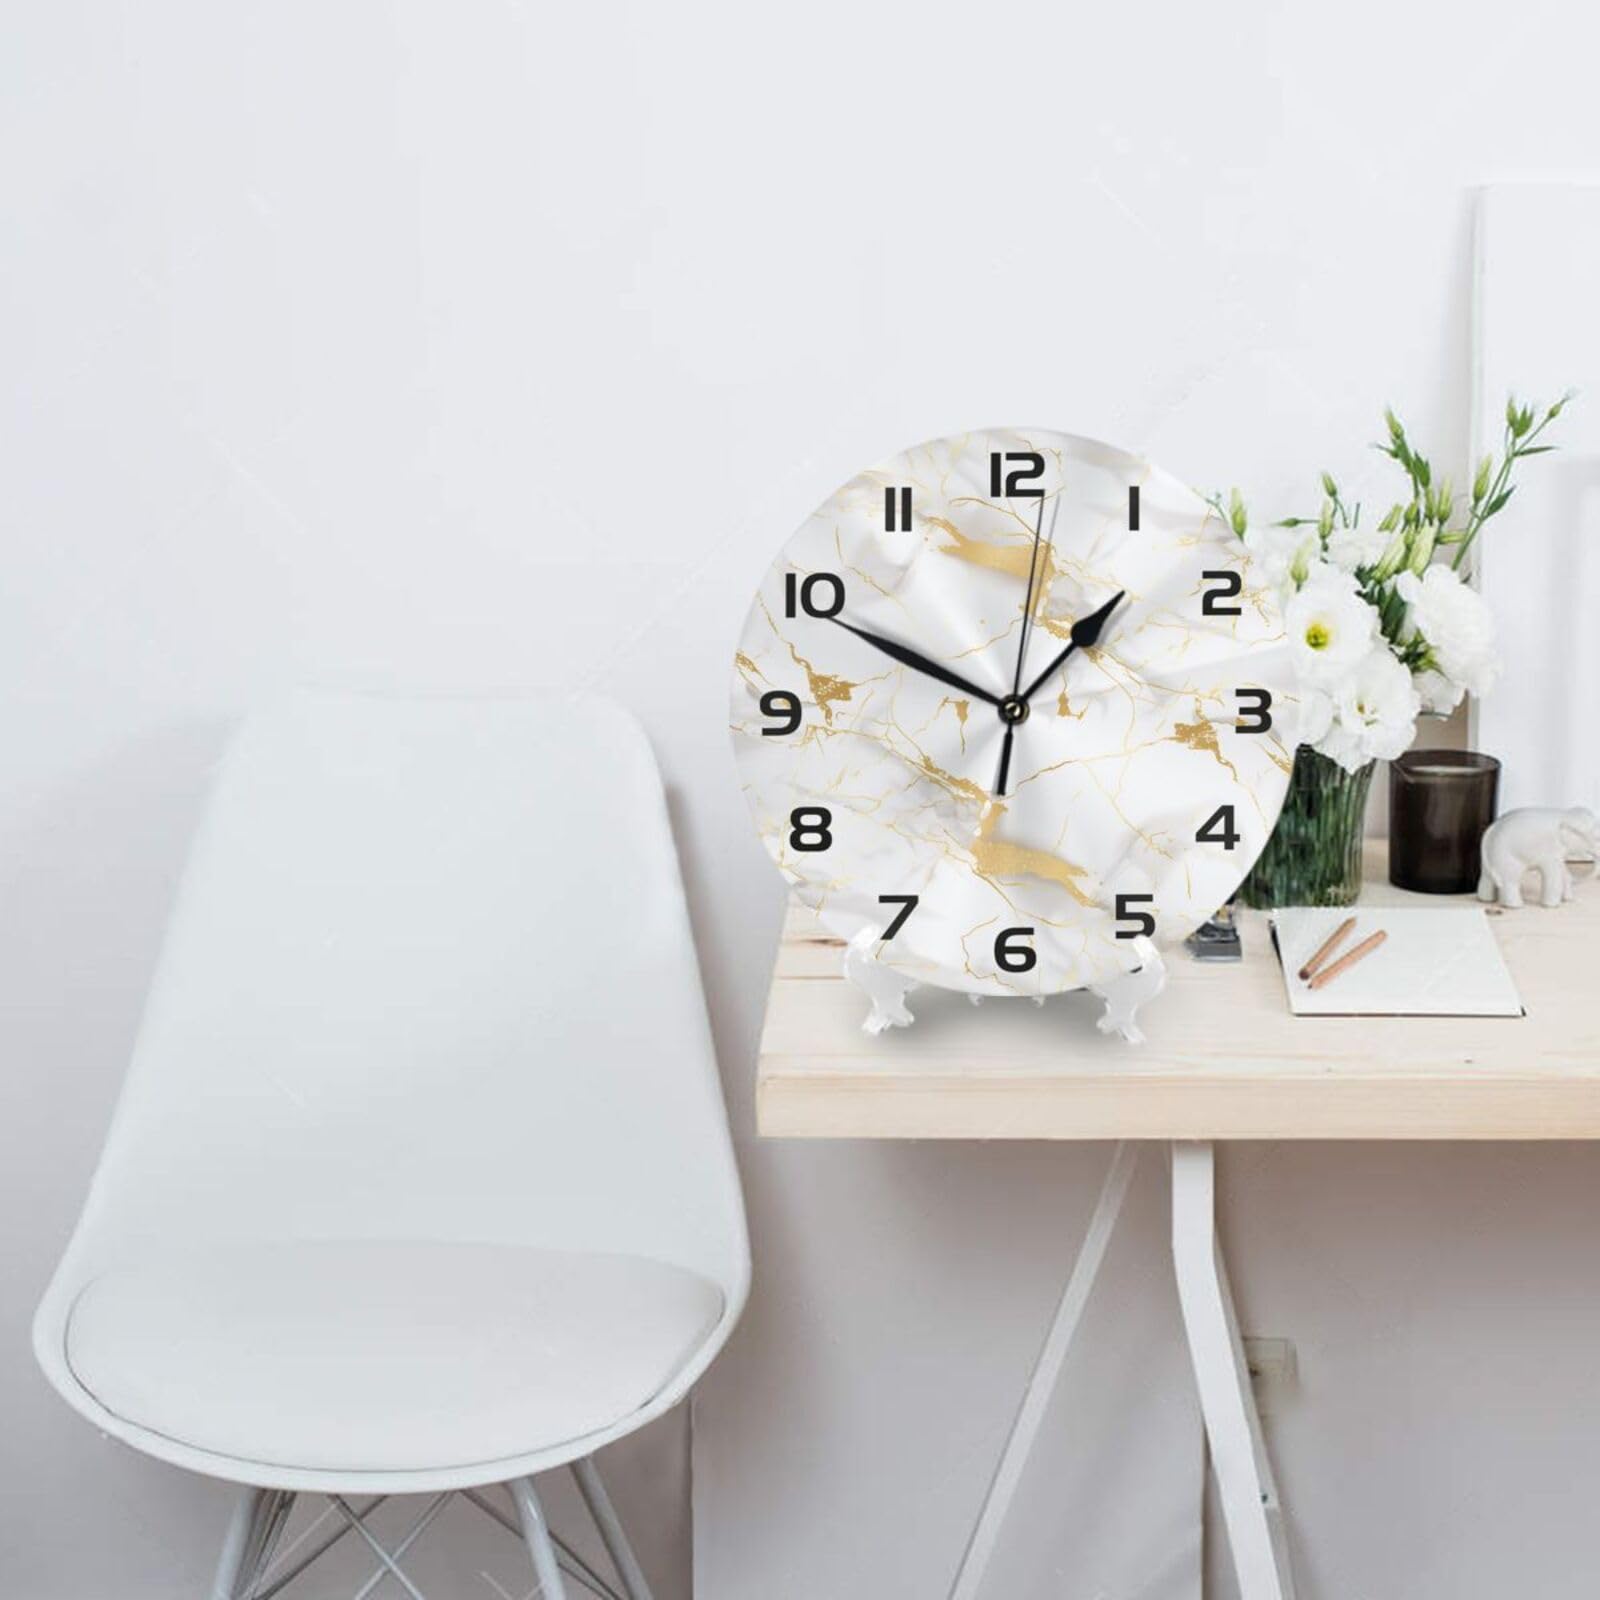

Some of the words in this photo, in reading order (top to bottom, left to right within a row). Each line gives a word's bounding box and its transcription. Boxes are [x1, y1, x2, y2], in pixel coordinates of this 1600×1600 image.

[990, 452, 1045, 499] 12
[885, 487, 912, 532] 11
[1129, 486, 1140, 531] 1
[785, 572, 846, 619] 10
[1202, 571, 1242, 616] 2
[760, 690, 802, 736] 9
[1235, 688, 1273, 734] 3
[790, 806, 833, 852] 8
[1195, 806, 1241, 850] 4
[878, 895, 919, 941] 7
[1115, 894, 1156, 939] 5
[994, 927, 1037, 973] 6
